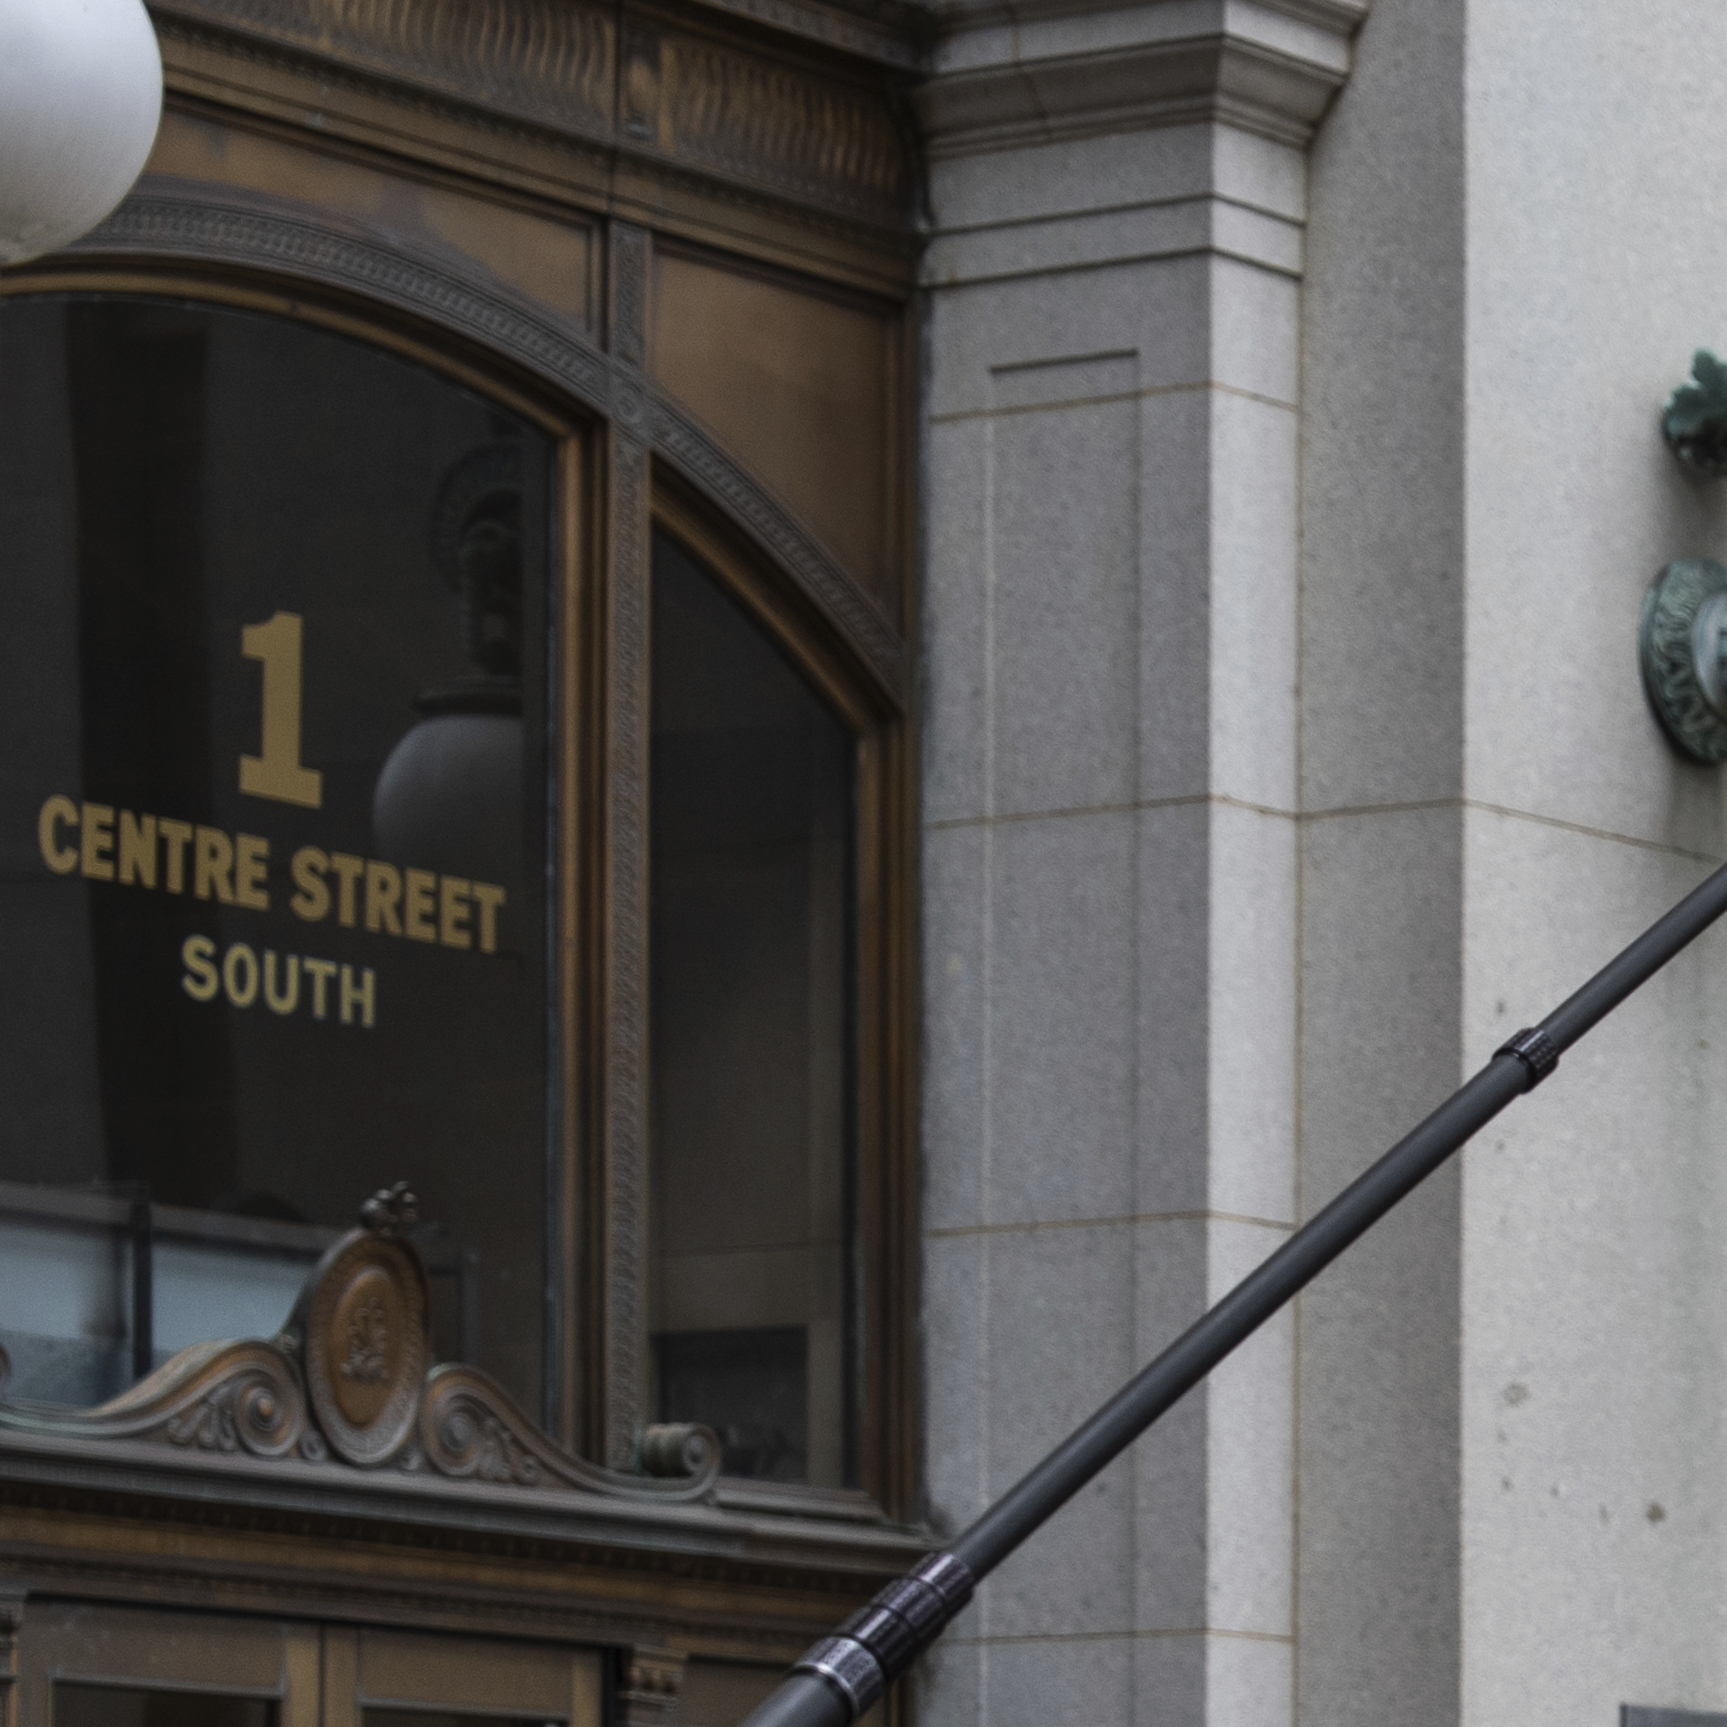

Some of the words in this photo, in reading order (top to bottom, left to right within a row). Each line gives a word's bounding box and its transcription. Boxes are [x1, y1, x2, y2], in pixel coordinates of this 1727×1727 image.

[238, 610, 324, 810] 1
[37, 794, 270, 912] CENTRE
[290, 846, 506, 954] STREET
[181, 934, 378, 1029] SOUTH
